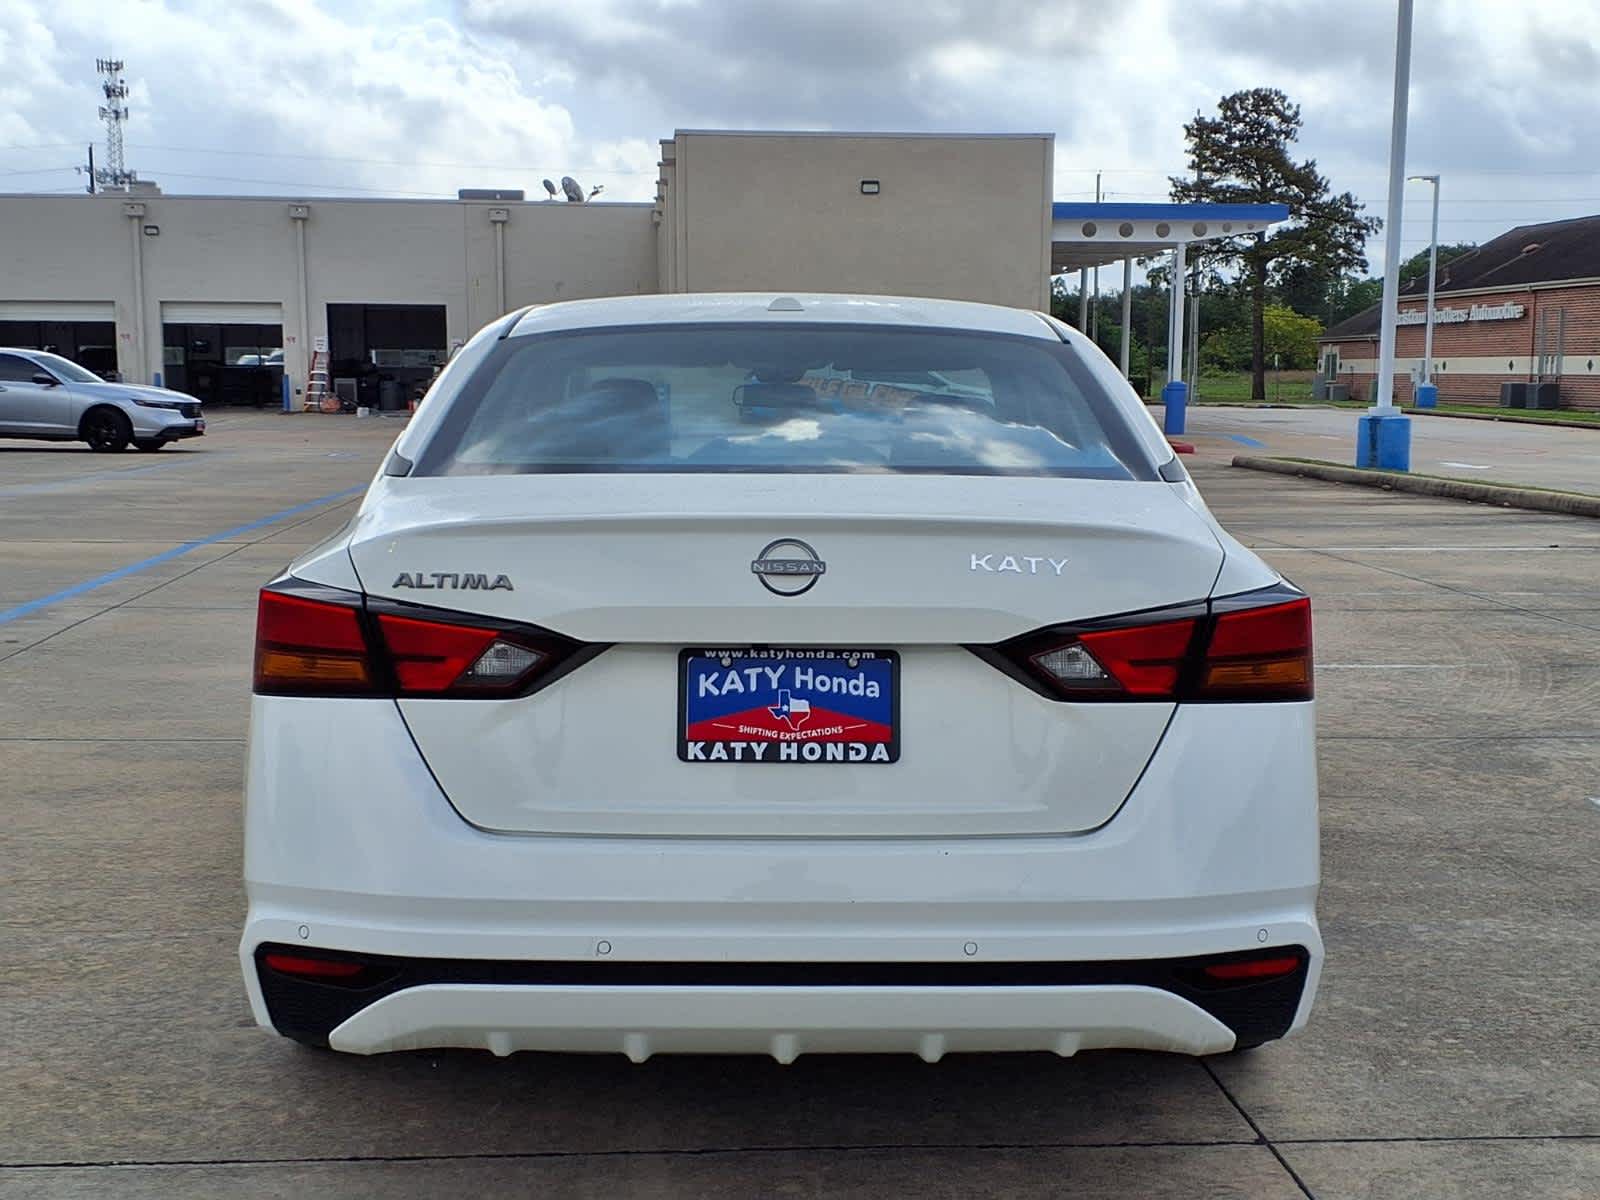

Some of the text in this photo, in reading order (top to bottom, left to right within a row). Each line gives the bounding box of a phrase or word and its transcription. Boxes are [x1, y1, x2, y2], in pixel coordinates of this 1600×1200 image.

[1433, 306, 1468, 323] rothers
[1469, 301, 1525, 320] Automotive
[753, 561, 825, 572] NISSAN
[970, 553, 1069, 576] KATY
[392, 572, 514, 590] ALTIMA
[704, 649, 876, 660] www.katyhonda.com
[699, 665, 881, 698] KATY Honda
[738, 725, 844, 741] SHIFTING EXPECTATIONS
[687, 742, 891, 761] KATY HONDA
